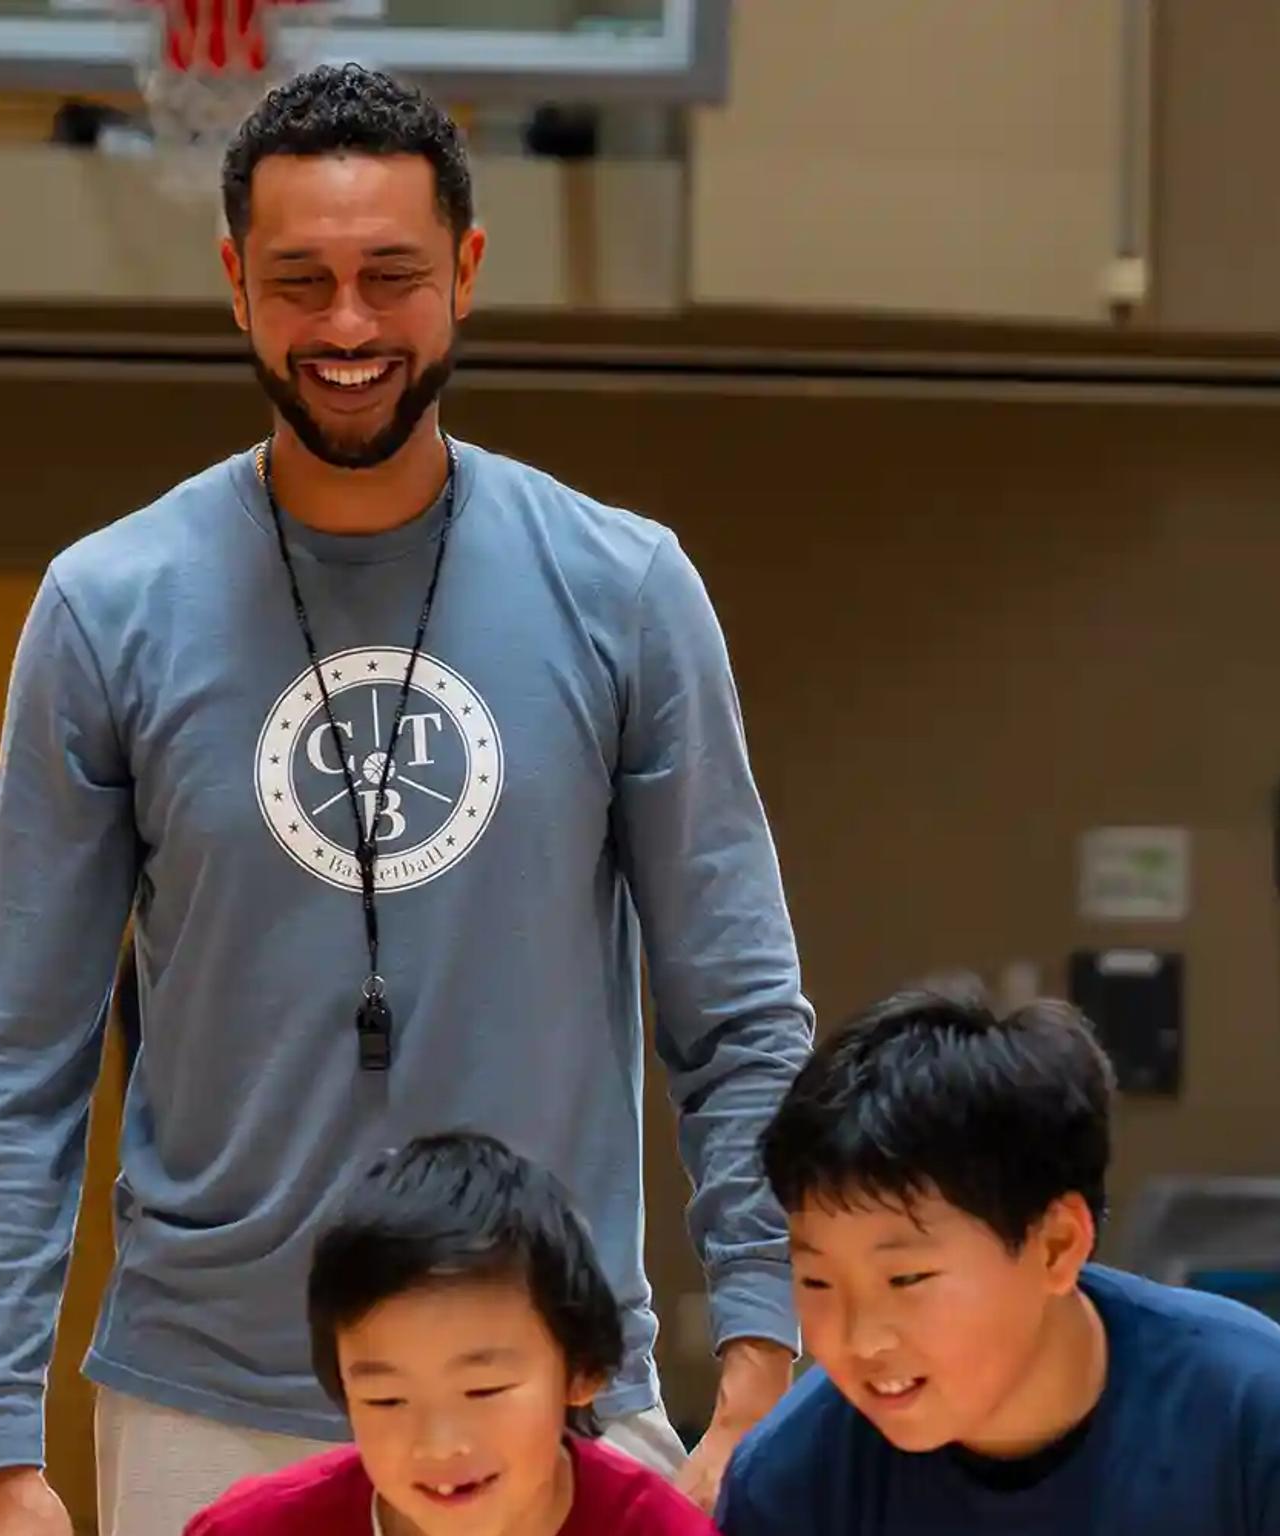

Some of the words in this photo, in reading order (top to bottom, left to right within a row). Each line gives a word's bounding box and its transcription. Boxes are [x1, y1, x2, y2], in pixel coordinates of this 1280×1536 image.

[306, 721, 355, 774] C
[398, 713, 442, 766] T
[358, 789, 406, 842] B
